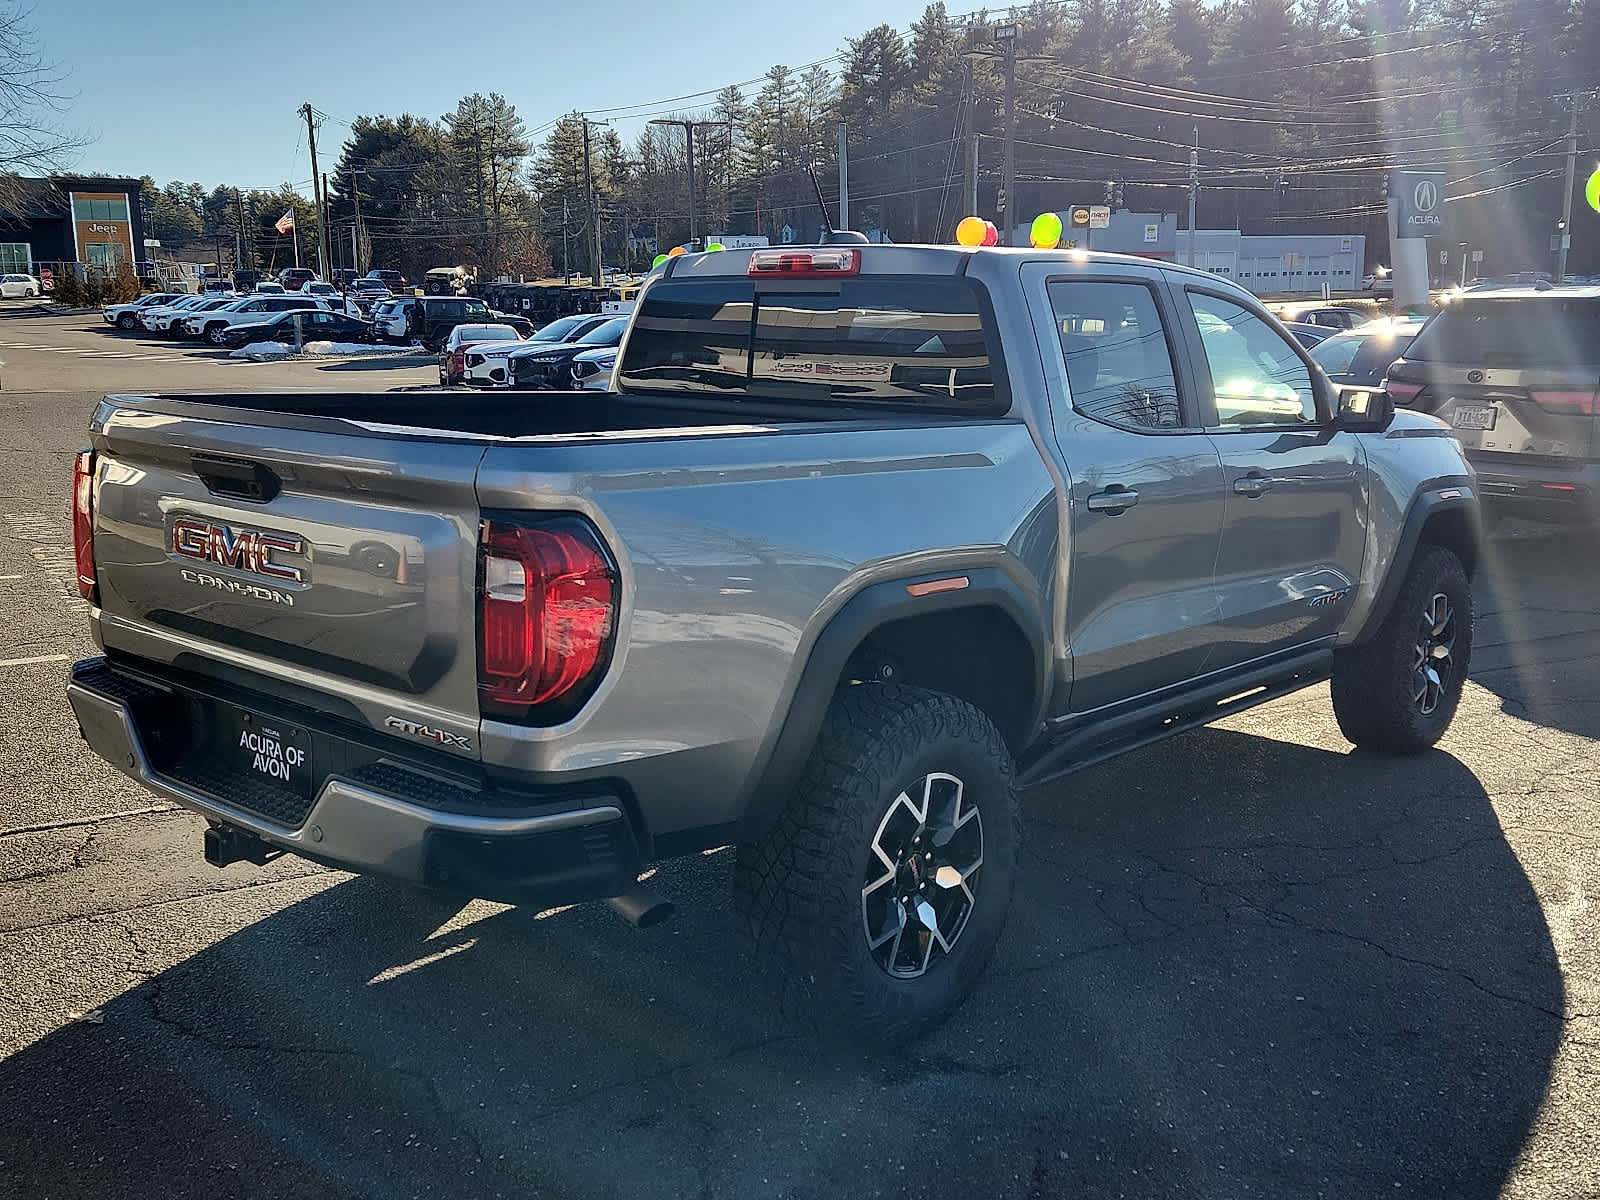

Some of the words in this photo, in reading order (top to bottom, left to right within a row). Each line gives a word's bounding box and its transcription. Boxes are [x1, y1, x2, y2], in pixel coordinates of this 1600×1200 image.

[88, 223, 118, 233] Jeep
[1408, 215, 1440, 225] ACURA
[172, 519, 303, 582] GMC
[180, 569, 295, 607] CANYON
[239, 730, 284, 761] ACURA
[285, 746, 305, 767] OF
[384, 715, 472, 751] AT4X
[252, 752, 290, 781] AVON
